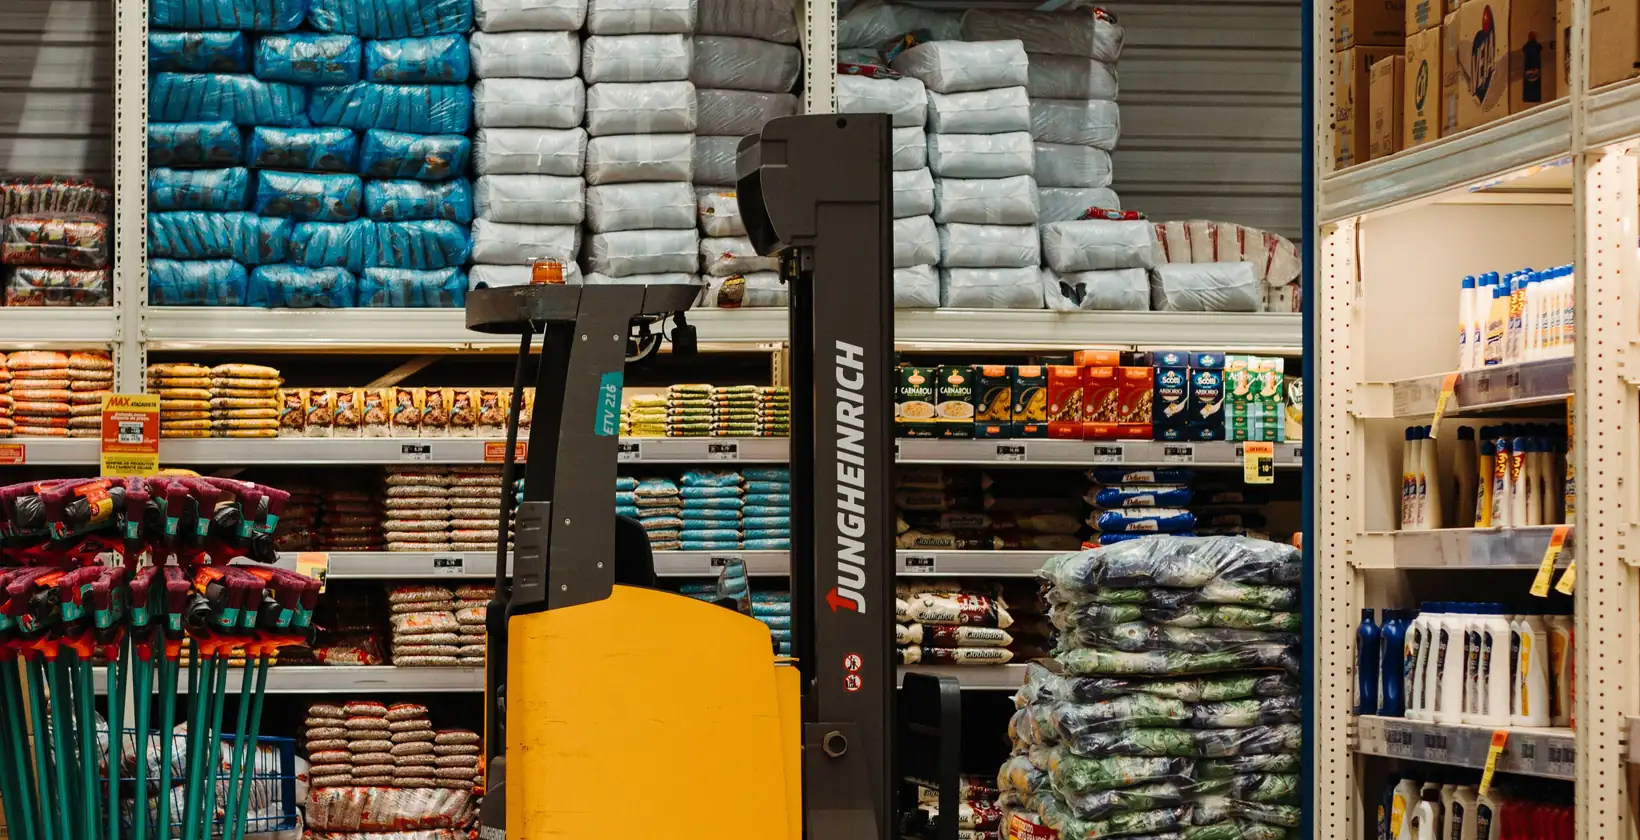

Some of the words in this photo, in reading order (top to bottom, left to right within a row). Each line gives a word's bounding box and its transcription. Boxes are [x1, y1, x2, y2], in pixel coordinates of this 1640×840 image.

[605, 384, 617, 408] 216
[901, 387, 932, 395] CARNAROLI
[107, 397, 131, 410] MAX
[603, 410, 615, 435] ETV
[835, 340, 866, 614] JUNGHEINRICH
[917, 612, 955, 620] Gladiador
[965, 631, 1004, 639] Gladiador
